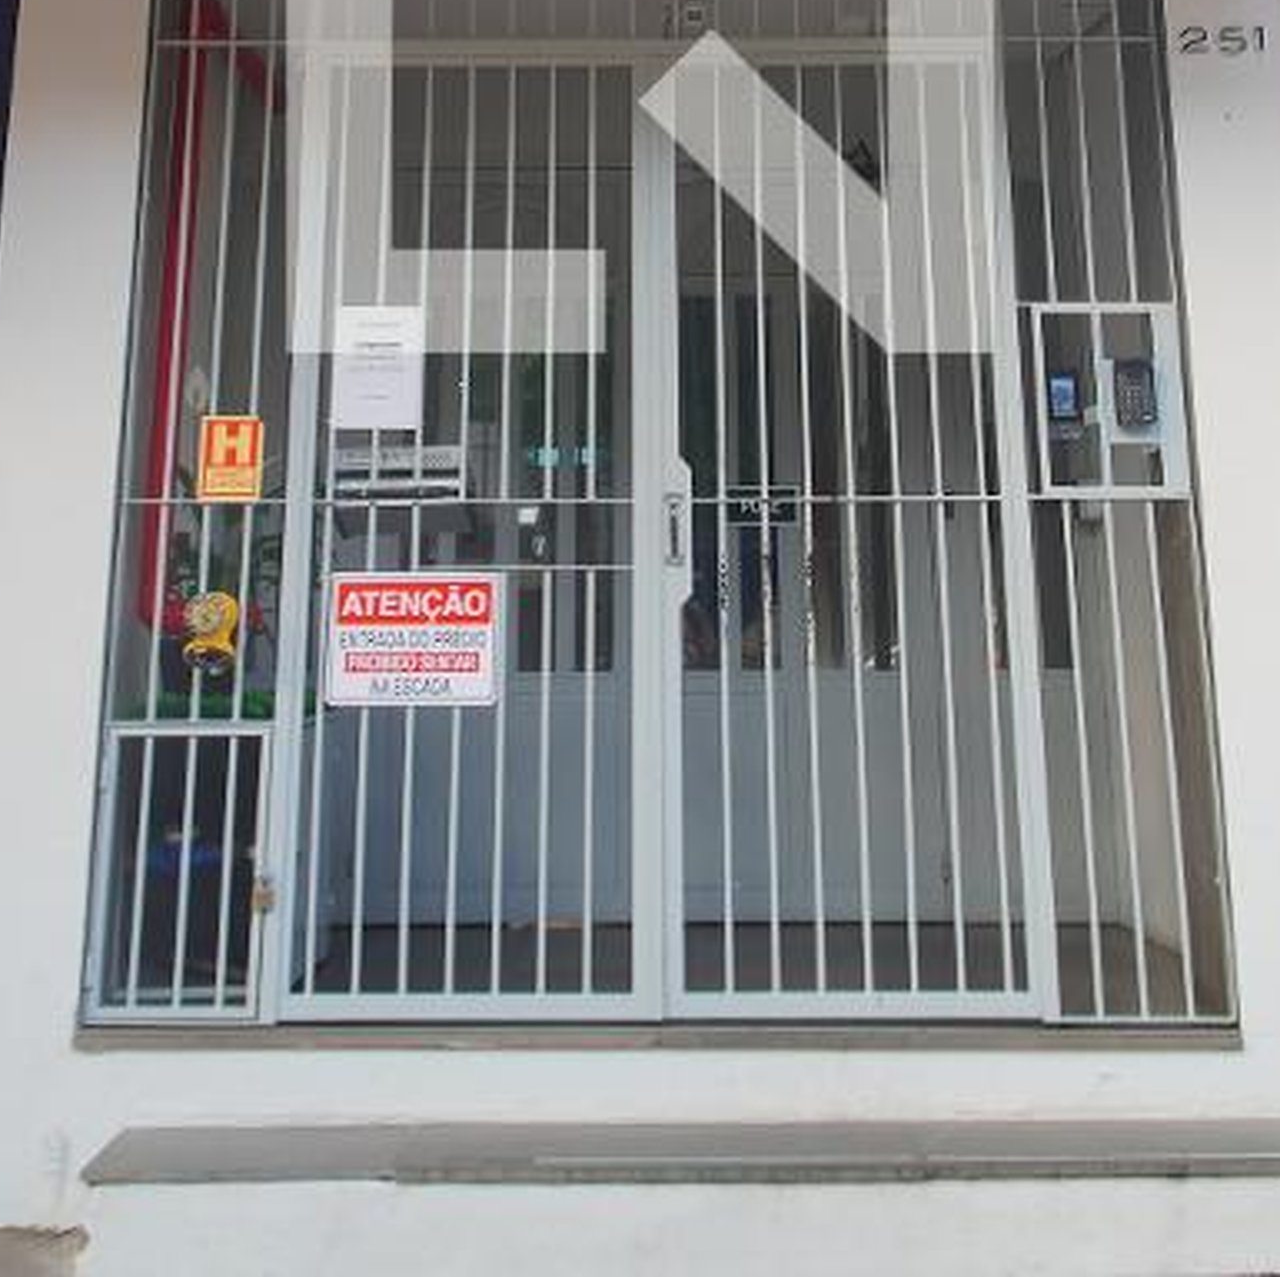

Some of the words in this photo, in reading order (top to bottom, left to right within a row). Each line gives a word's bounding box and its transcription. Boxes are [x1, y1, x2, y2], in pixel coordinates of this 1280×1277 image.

[1179, 25, 1265, 57] 251
[212, 424, 251, 464] H
[341, 585, 488, 623] ATENÇÃO
[393, 677, 452, 697] ESCADA
